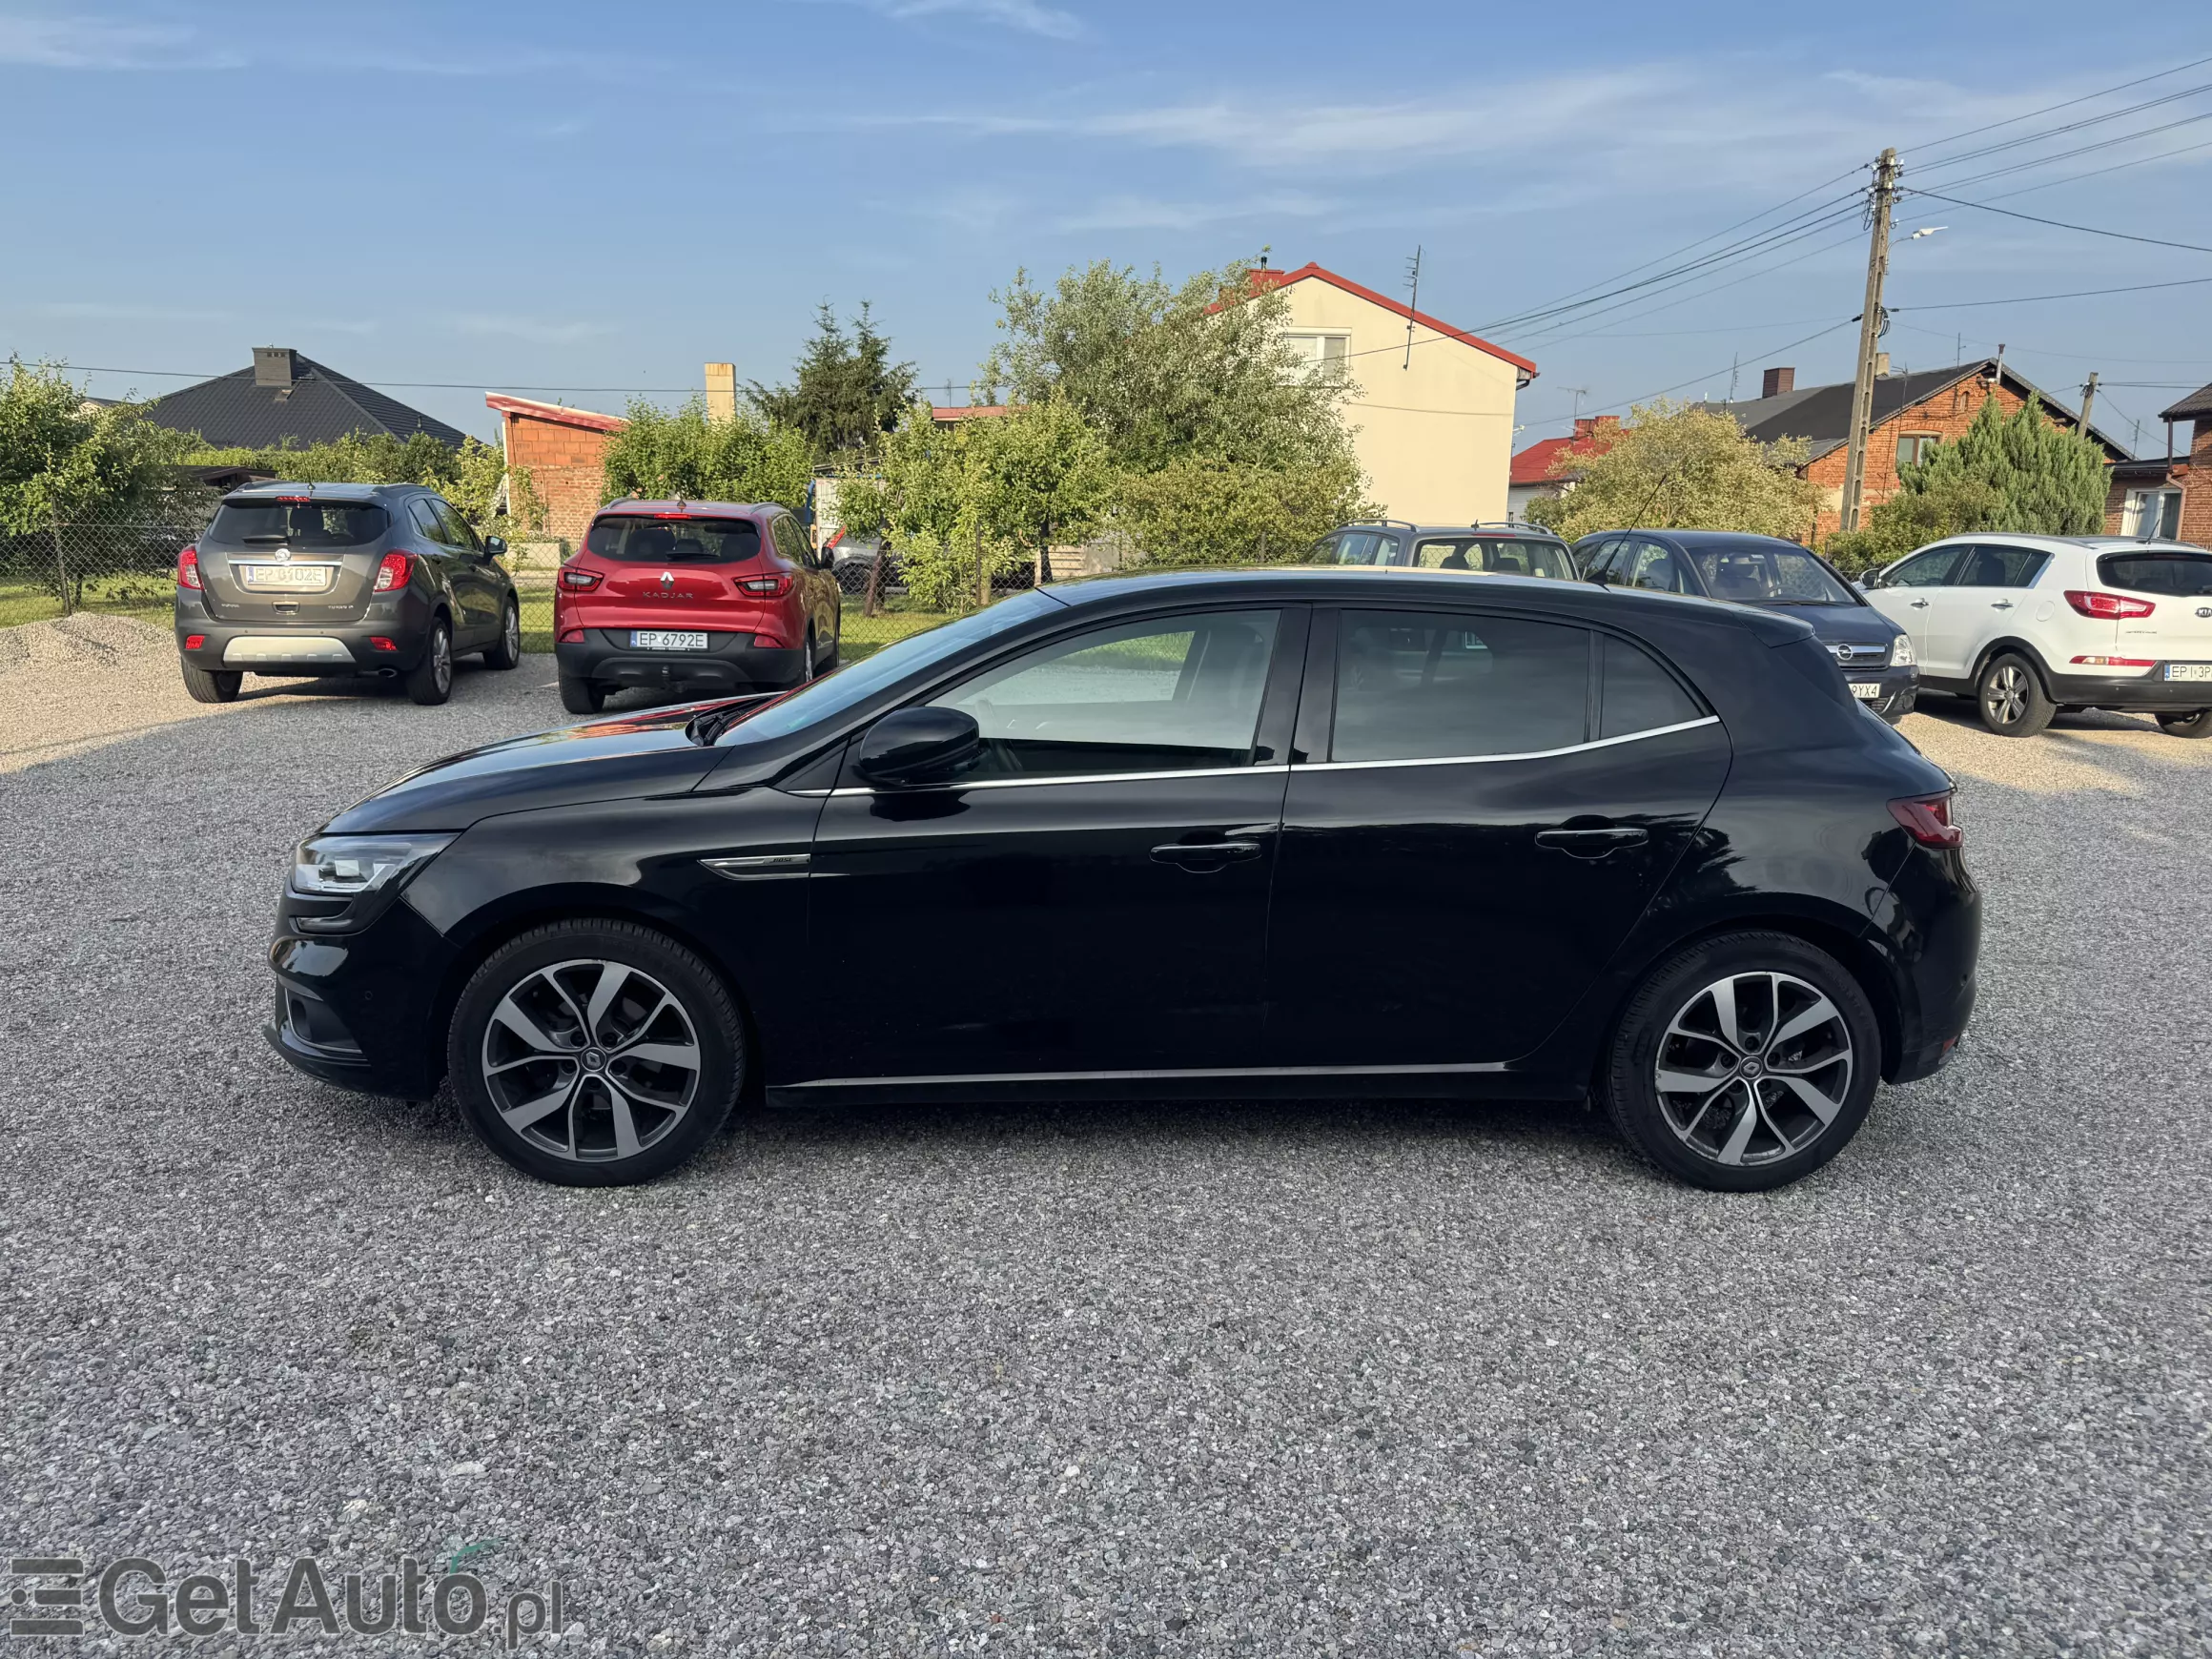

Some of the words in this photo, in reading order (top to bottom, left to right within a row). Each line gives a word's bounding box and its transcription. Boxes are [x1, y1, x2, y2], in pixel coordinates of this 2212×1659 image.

[256, 567, 274, 582] EP
[643, 591, 694, 600] KADJAR
[640, 632, 657, 645] EP
[662, 633, 705, 647] 6792E
[2198, 666, 2212, 678] 3P
